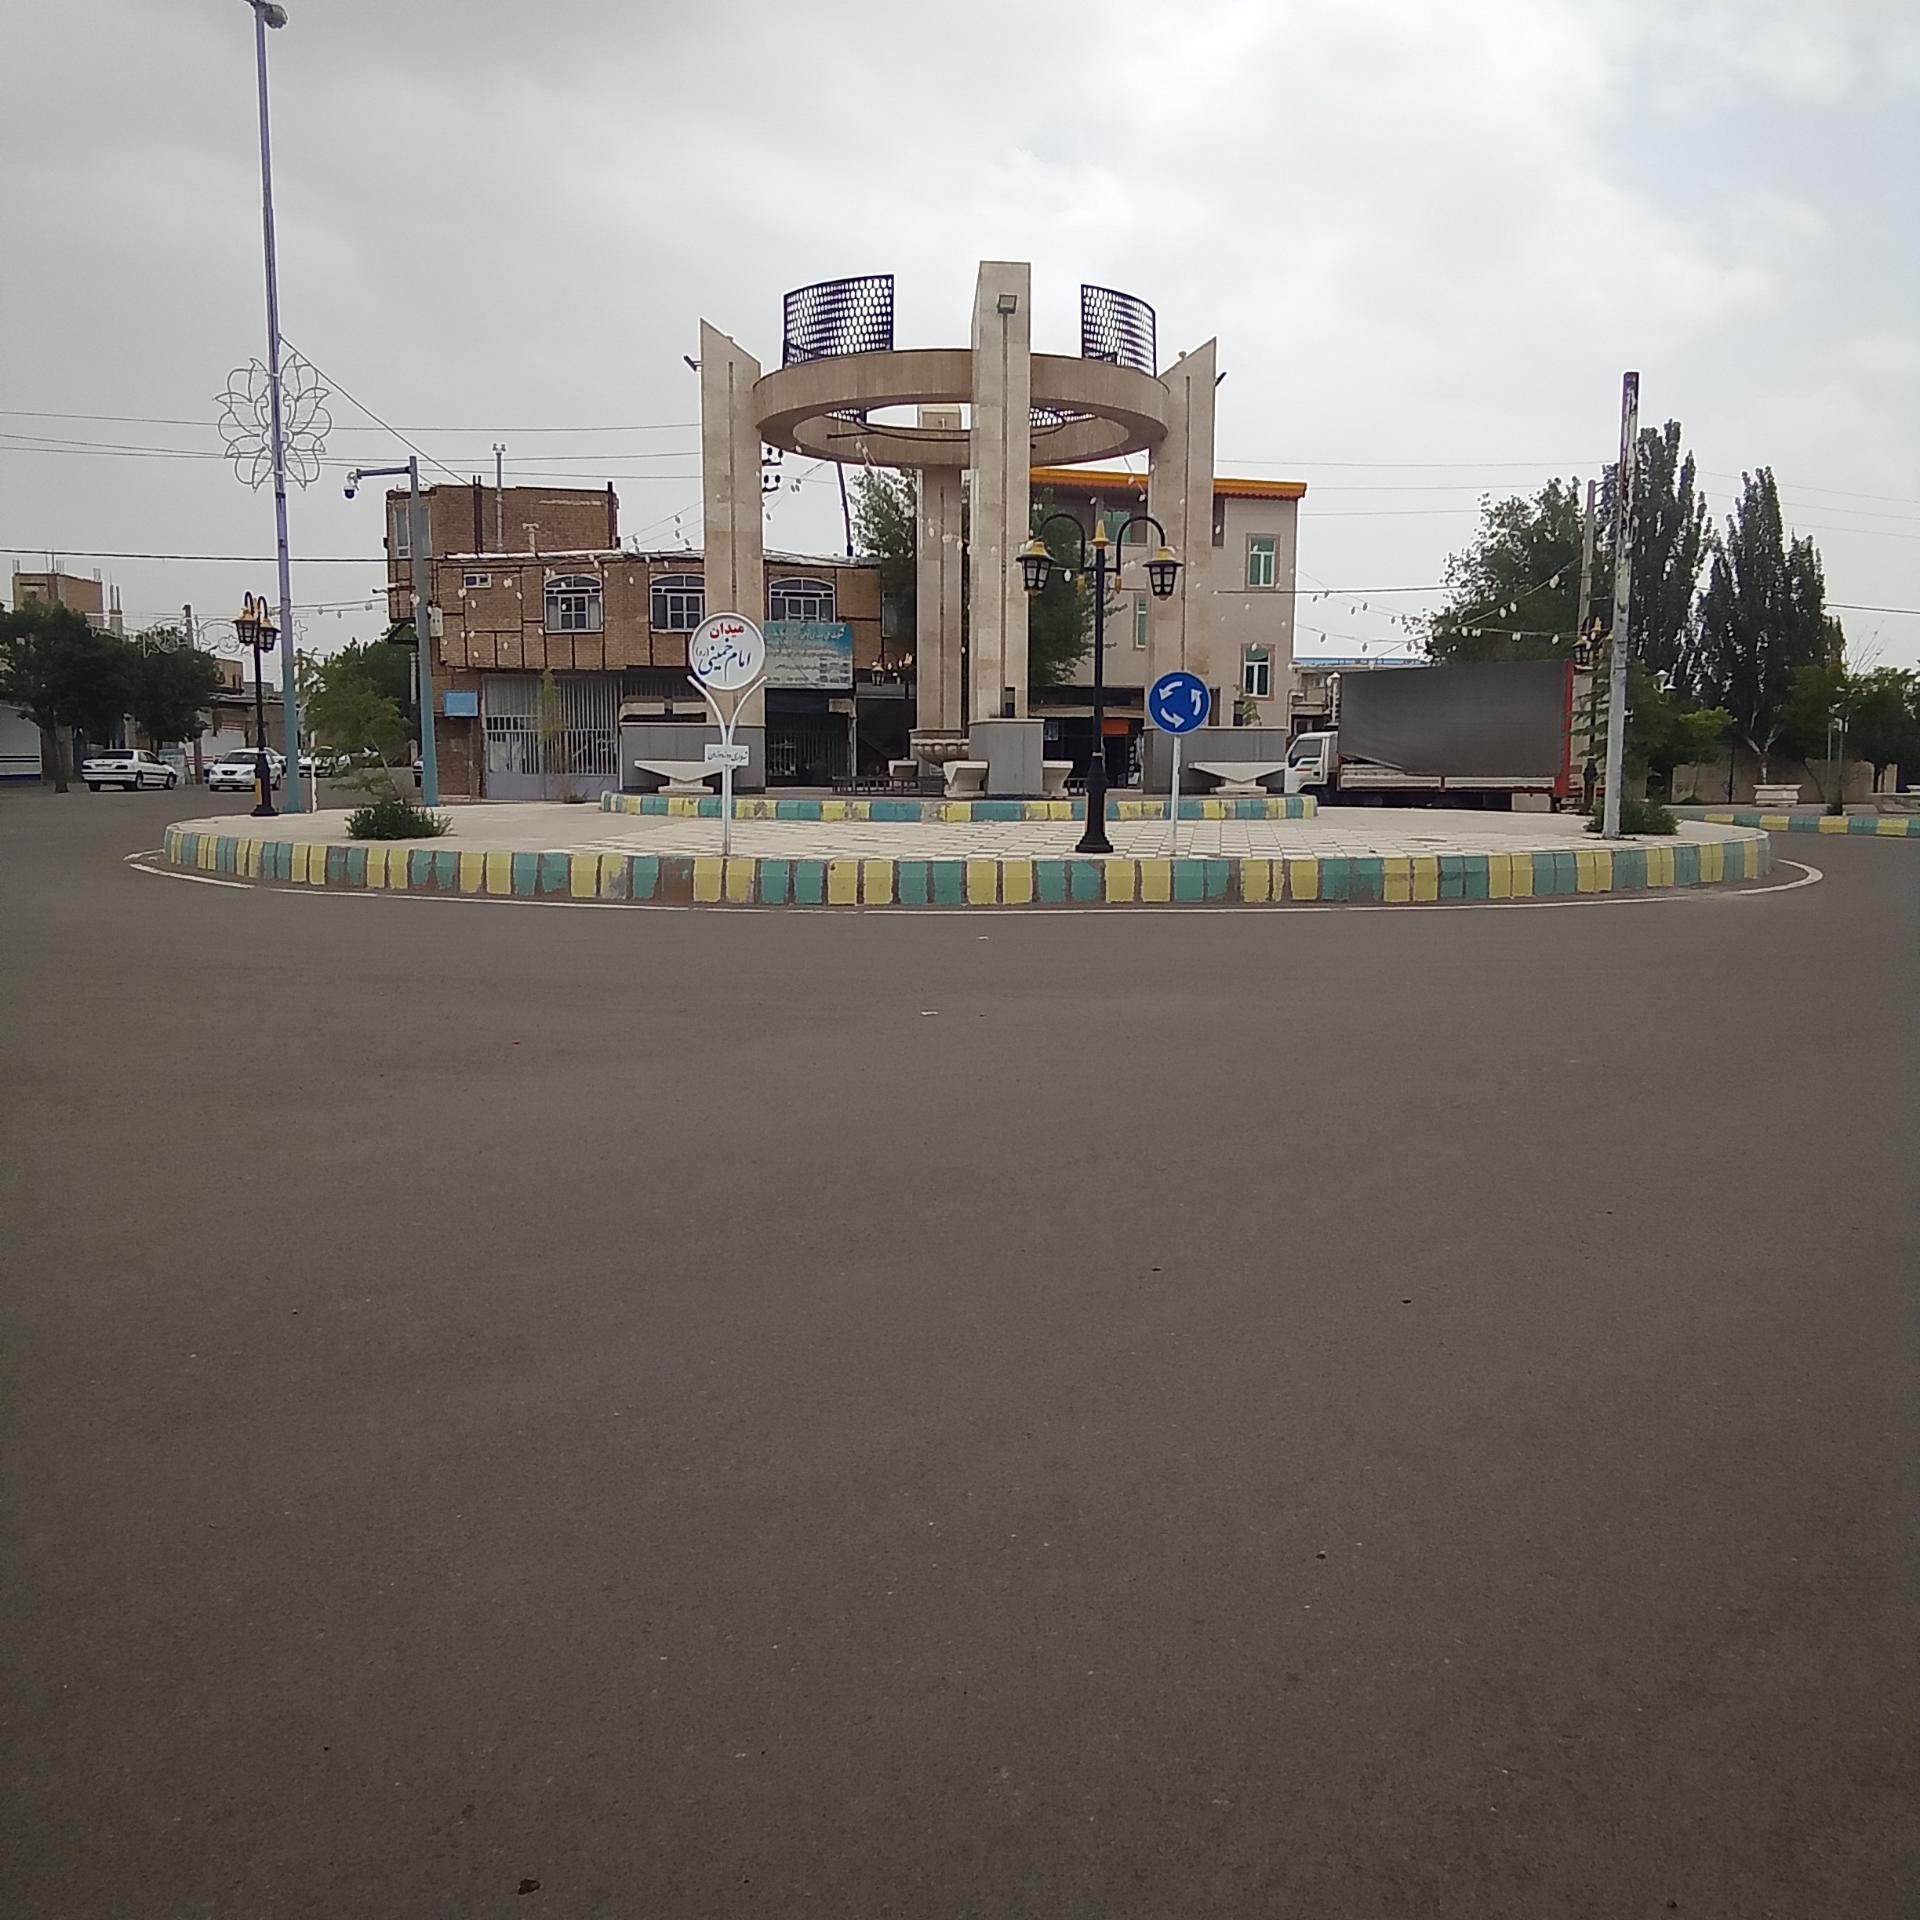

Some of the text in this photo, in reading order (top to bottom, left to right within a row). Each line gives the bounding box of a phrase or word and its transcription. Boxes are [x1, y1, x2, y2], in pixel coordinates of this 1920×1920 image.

[709, 622, 745, 639] میدان
[698, 637, 733, 675] خمینی
[724, 649, 751, 682] امام
